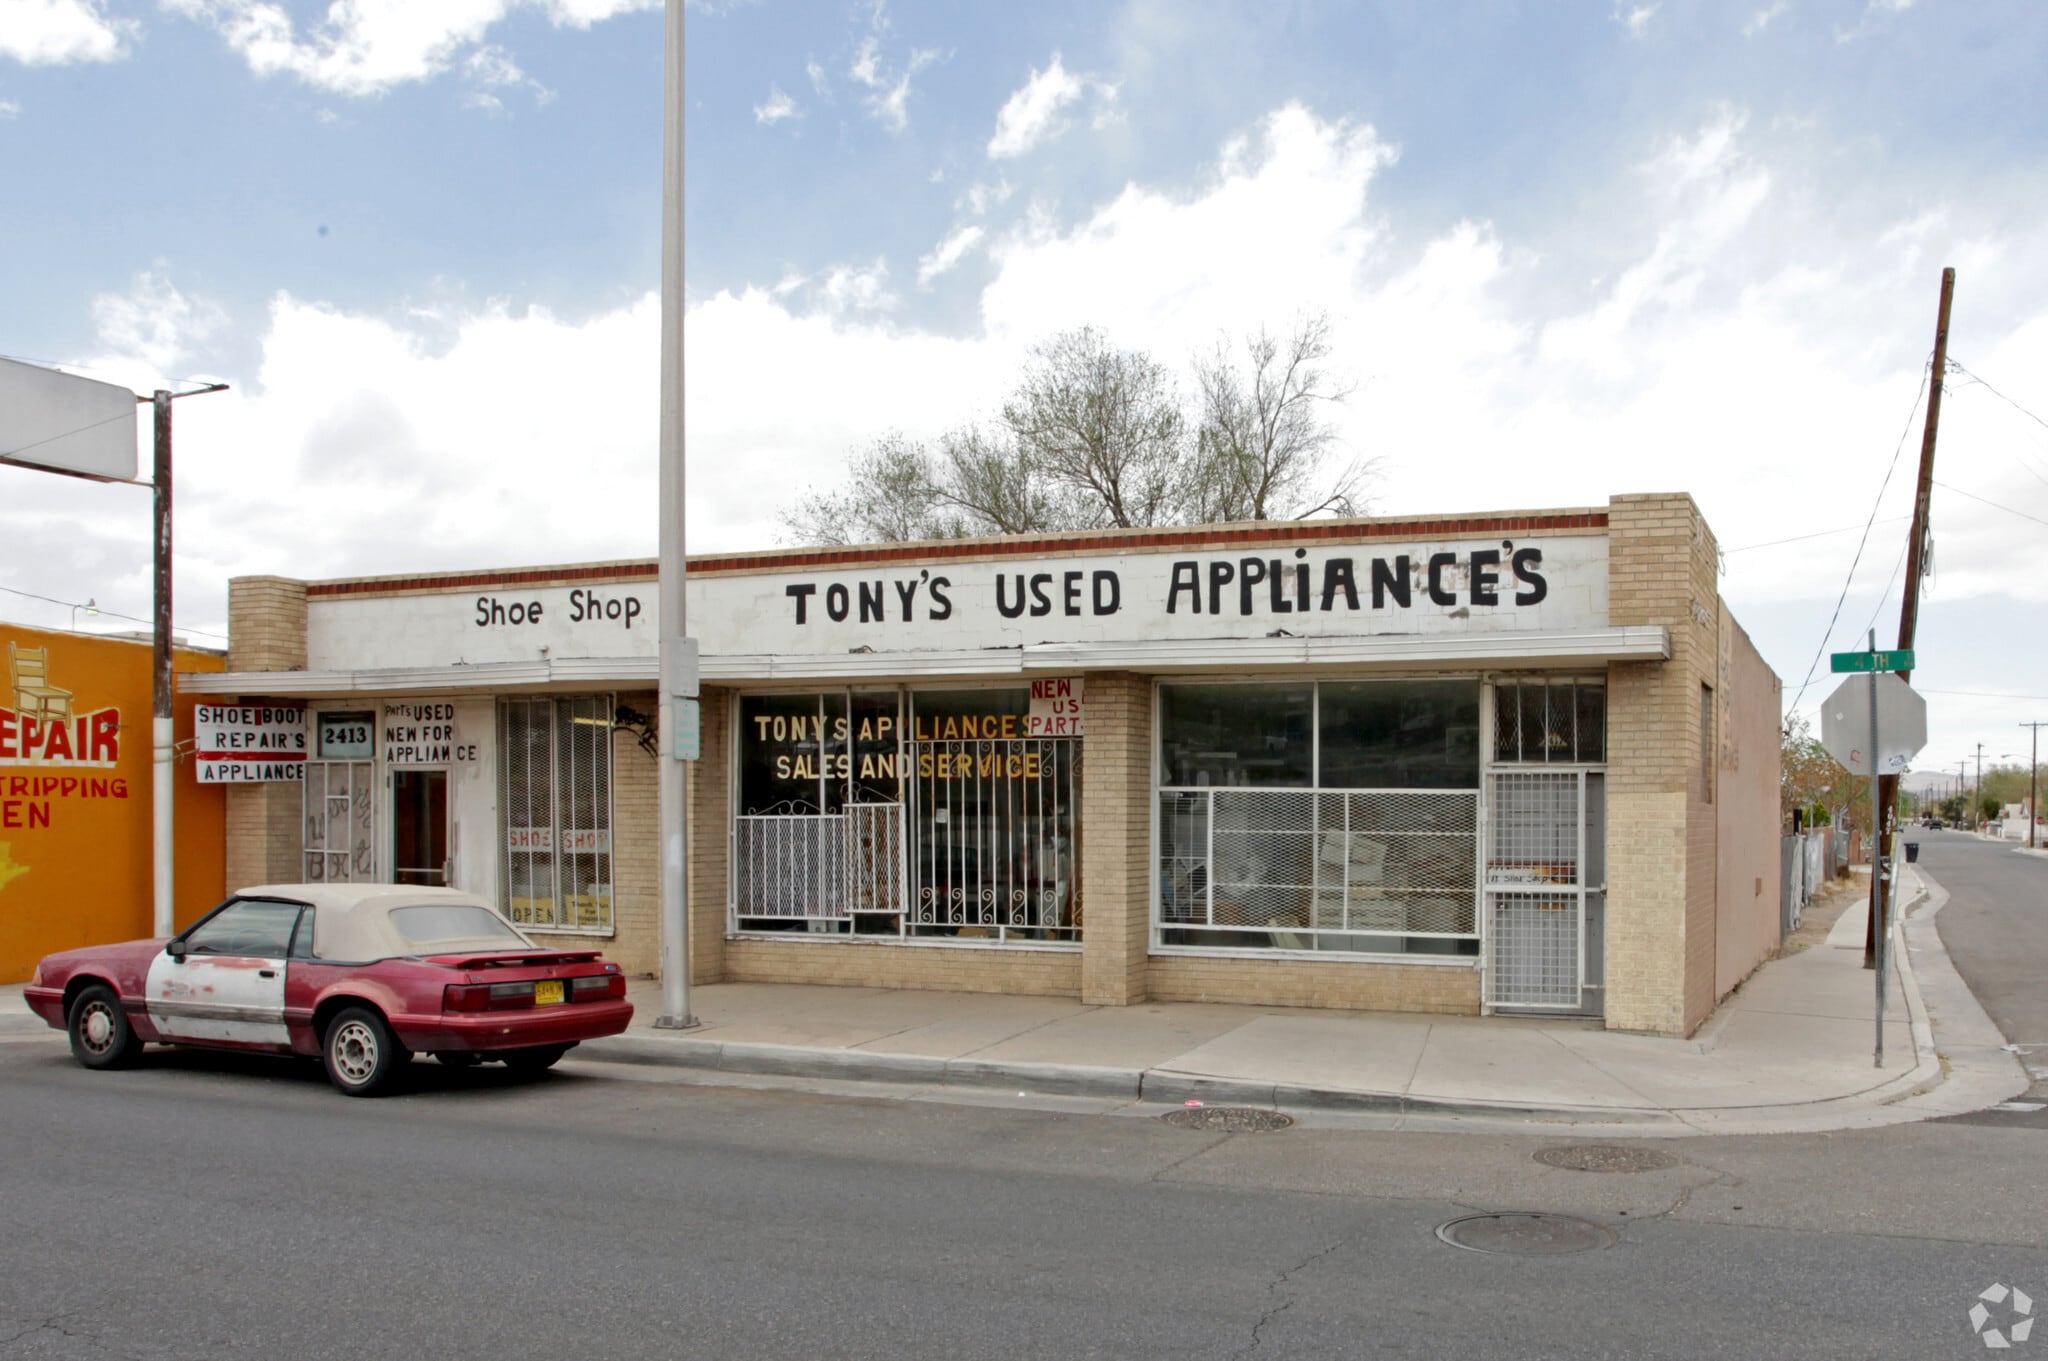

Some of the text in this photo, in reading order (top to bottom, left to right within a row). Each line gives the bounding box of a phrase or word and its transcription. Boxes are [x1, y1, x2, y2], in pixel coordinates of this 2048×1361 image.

[786, 569, 952, 625] TONY'S
[995, 570, 1121, 619] USED
[475, 589, 641, 629] Shoe Shop
[1031, 680, 1071, 699] NEW
[199, 707, 305, 725] SHOE BOOT
[414, 704, 454, 721] USED
[1052, 699, 1084, 715] US
[386, 725, 452, 743] NEW FOR
[858, 714, 1034, 742] APLIANCES
[1030, 716, 1084, 735] PART
[215, 732, 305, 749] REPAIR'S
[325, 726, 367, 744] 2413
[204, 764, 304, 781] APPLIANCE
[776, 752, 1041, 780] SALES AND SERVICE
[510, 830, 609, 849] SHOE SHOP
